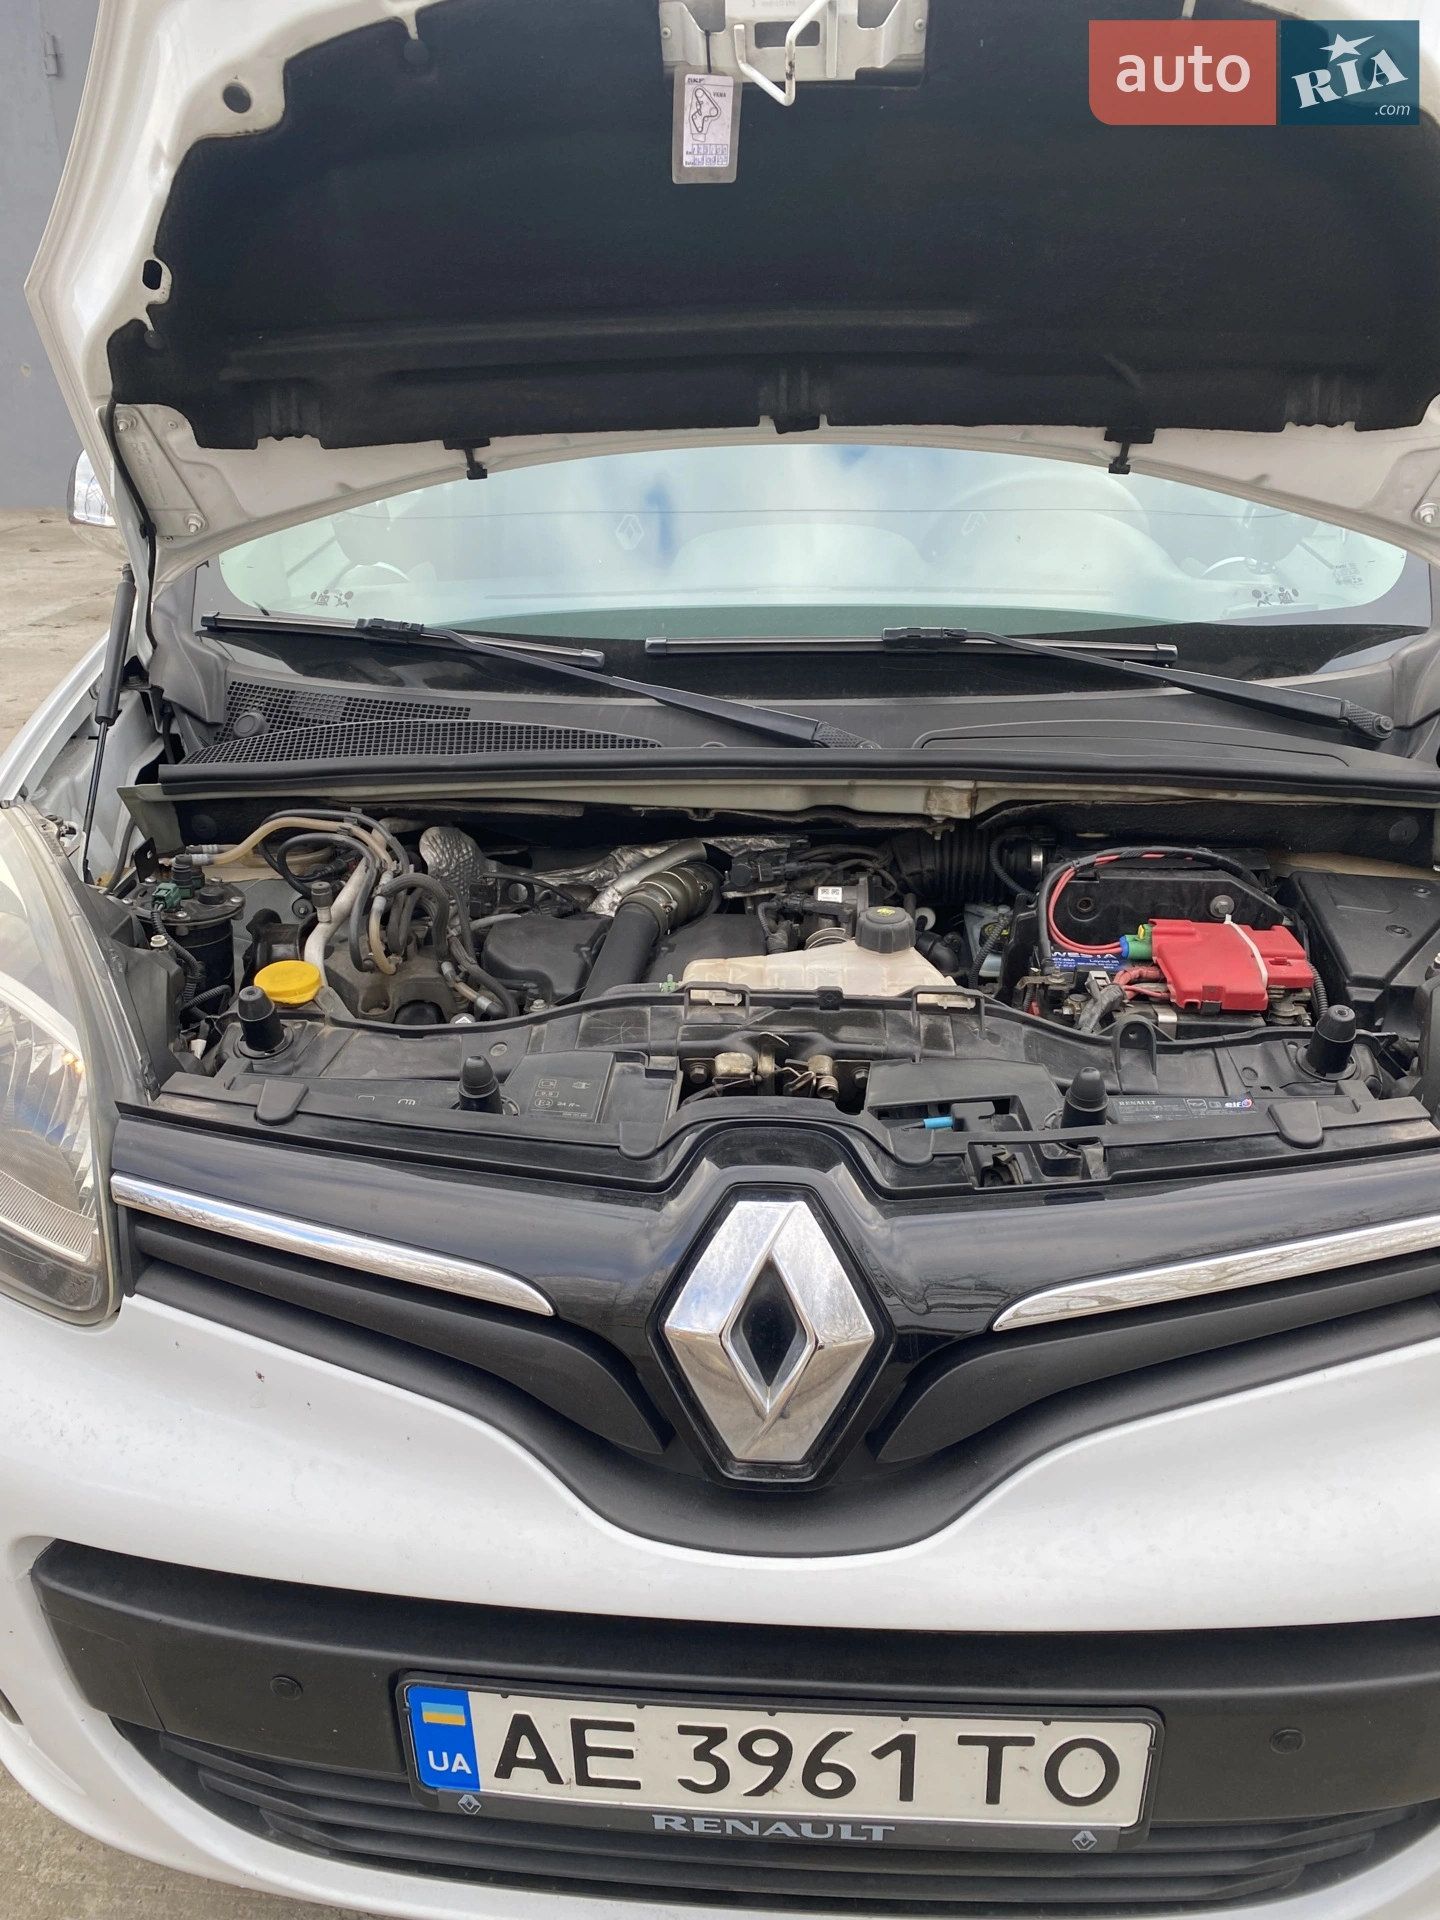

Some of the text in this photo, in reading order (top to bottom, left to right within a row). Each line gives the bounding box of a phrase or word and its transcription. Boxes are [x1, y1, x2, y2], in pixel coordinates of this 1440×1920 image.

[427, 1750, 472, 1775] UA
[493, 1713, 1121, 1808] AE 3961 TO
[651, 1813, 896, 1842] RENAULT
